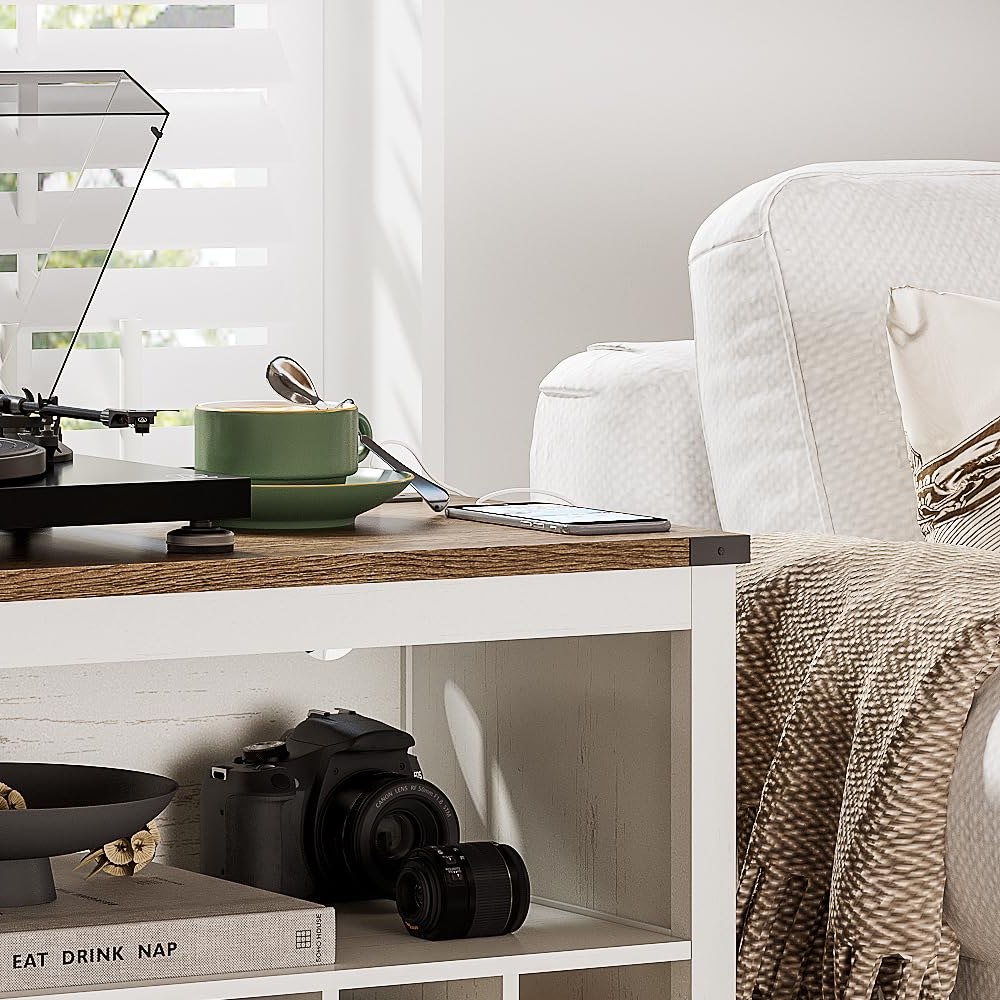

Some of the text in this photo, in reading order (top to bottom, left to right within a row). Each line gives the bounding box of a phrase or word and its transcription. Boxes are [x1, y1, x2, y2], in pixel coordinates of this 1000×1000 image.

[375, 791, 393, 808] CANON
[394, 785, 408, 794] LENS
[12, 941, 178, 970] EAT DRINK NAP
